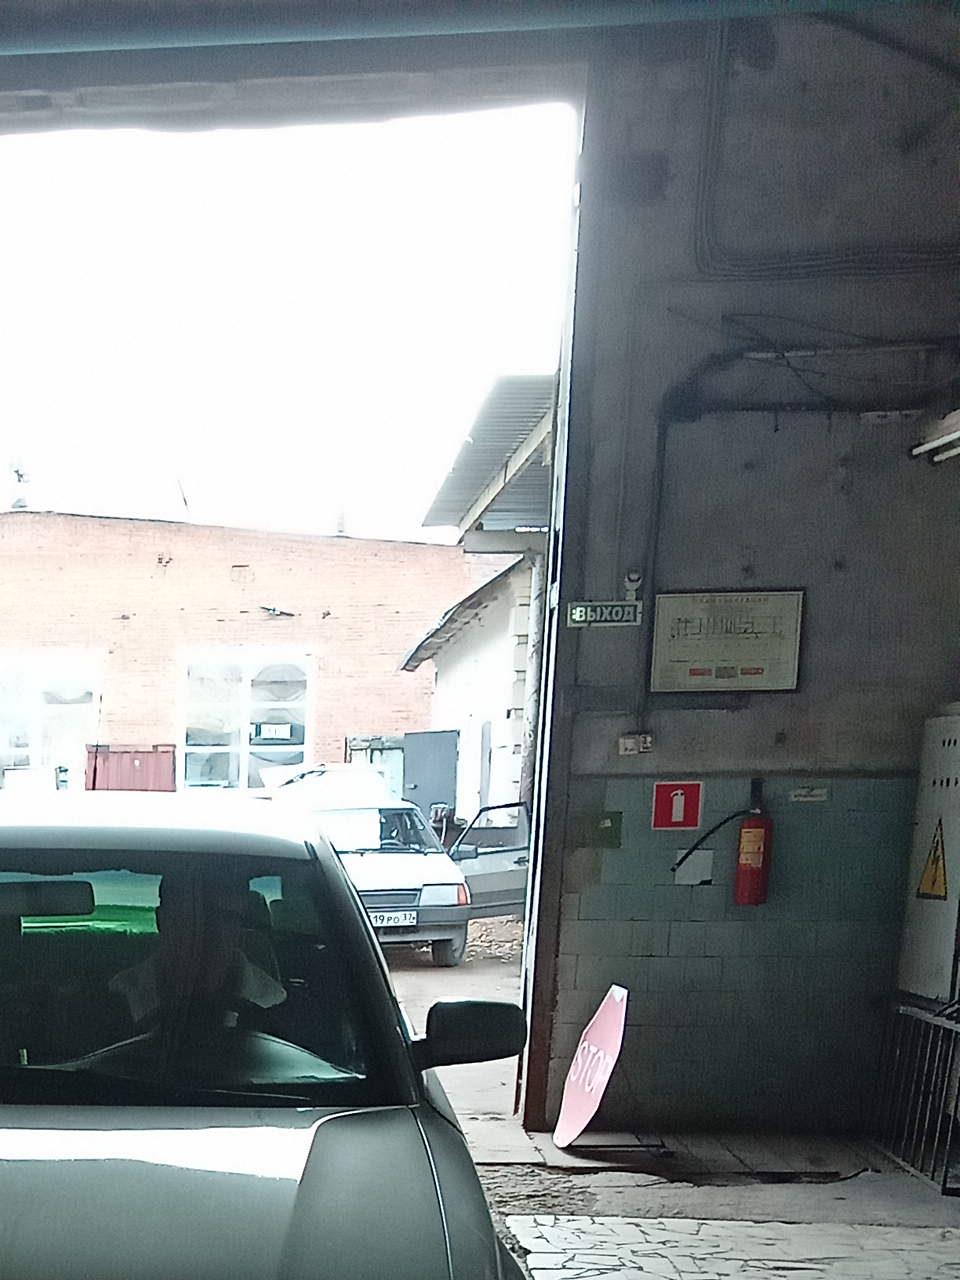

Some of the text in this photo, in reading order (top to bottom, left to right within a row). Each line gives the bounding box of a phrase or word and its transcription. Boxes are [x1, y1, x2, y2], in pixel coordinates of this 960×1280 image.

[575, 606, 635, 623] ВЫХОД
[371, 914, 400, 924] 19РО
[570, 1040, 613, 1094] STOP
